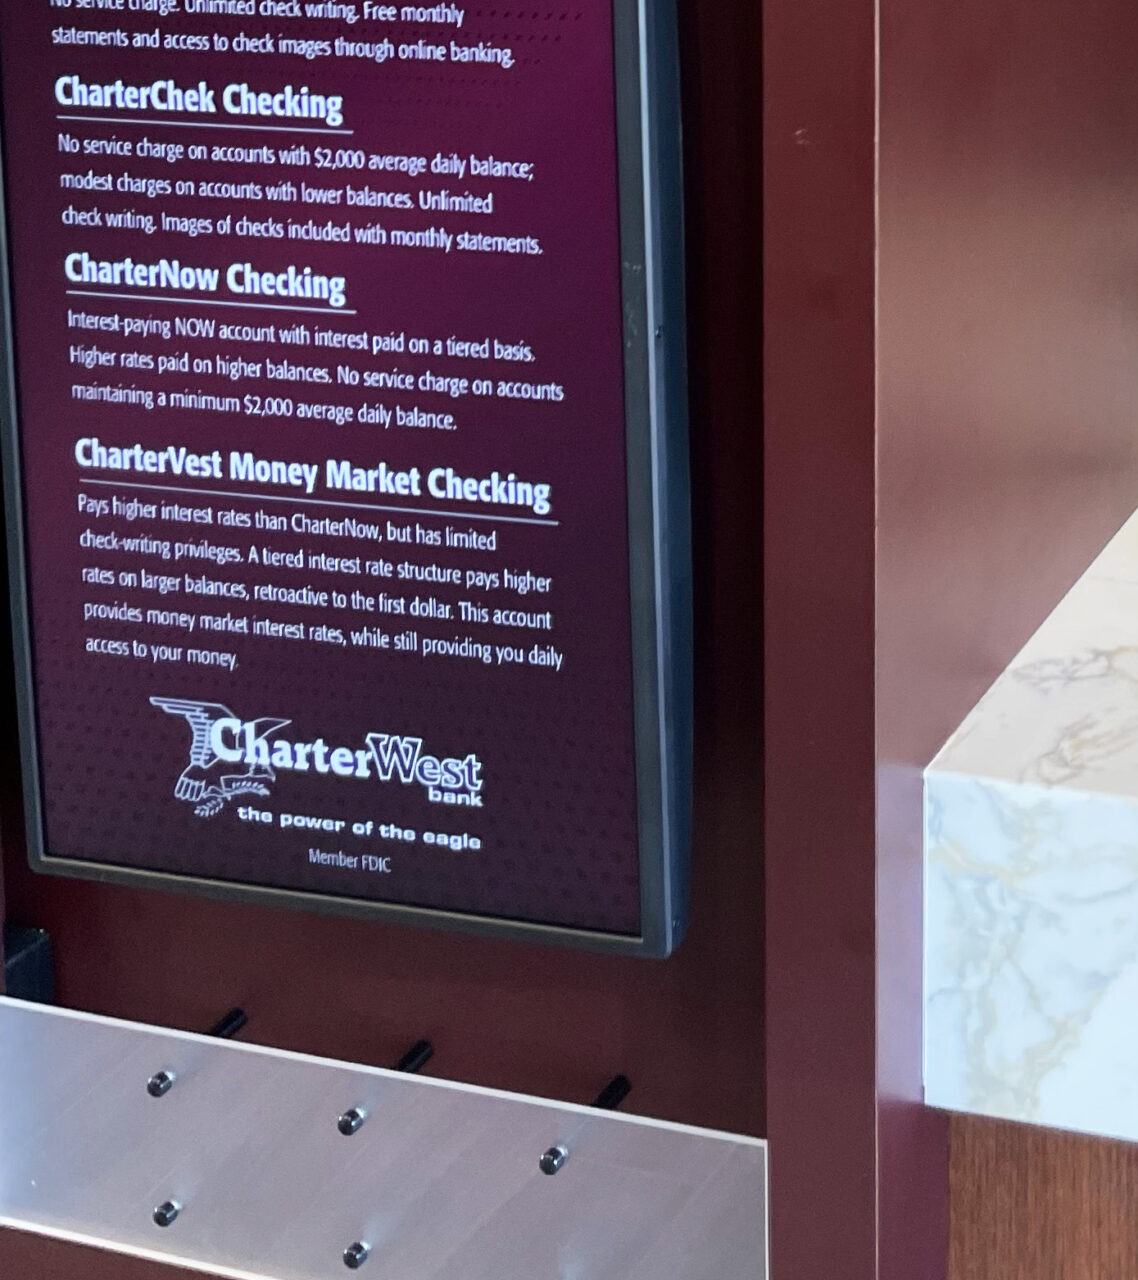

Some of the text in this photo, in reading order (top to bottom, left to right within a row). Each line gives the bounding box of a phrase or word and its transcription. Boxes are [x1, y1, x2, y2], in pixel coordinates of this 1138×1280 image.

[362, 0, 398, 22] Free
[400, 1, 465, 29] monthly
[51, 26, 130, 47] statements
[131, 27, 161, 49] and
[163, 33, 211, 51] access
[212, 32, 230, 52] to
[231, 31, 276, 54] check
[278, 33, 332, 61] images
[334, 36, 395, 63] through
[397, 39, 447, 62] online
[54, 74, 344, 127] CharterChek Checking
[57, 132, 535, 182] No service charge on accounts with $2,000 average daily balance;
[59, 169, 494, 214] modest charges on accounts with lower balances. Unlimited
[61, 204, 103, 227] check
[161, 211, 214, 238] Images
[216, 214, 232, 235] of
[235, 215, 285, 239] checks
[287, 217, 352, 243] included
[353, 222, 387, 245] with
[390, 226, 454, 254] monthly
[455, 231, 544, 255] statements.
[64, 251, 347, 308] CharterNow Checking
[67, 308, 536, 363] Interest-paying NOW account with interest paid on a tiered basis.
[69, 344, 565, 402] Higher rates paid on higher balances. No service charge on accounts
[71, 381, 458, 431] maintaining a minimum $2,000 average daily balance.
[74, 437, 552, 516] CharterVest Money Market Checking
[77, 493, 497, 551] Pays higher interest rates than CharterNow, but has limited
[79, 528, 552, 595] check-writing privileges. A tiered interest rate structure pays higher
[81, 567, 552, 631] rates on larger balances, retroactive to the first dollar. This account
[83, 600, 564, 672] provides money market interest rates, while still providing you daily
[85, 637, 130, 656] access
[132, 639, 148, 658] to
[150, 644, 183, 664] your
[211, 717, 484, 791] CharterWest
[428, 786, 484, 808] bank
[236, 805, 482, 852] the power of the eagle
[308, 847, 392, 874] Member FDIC
